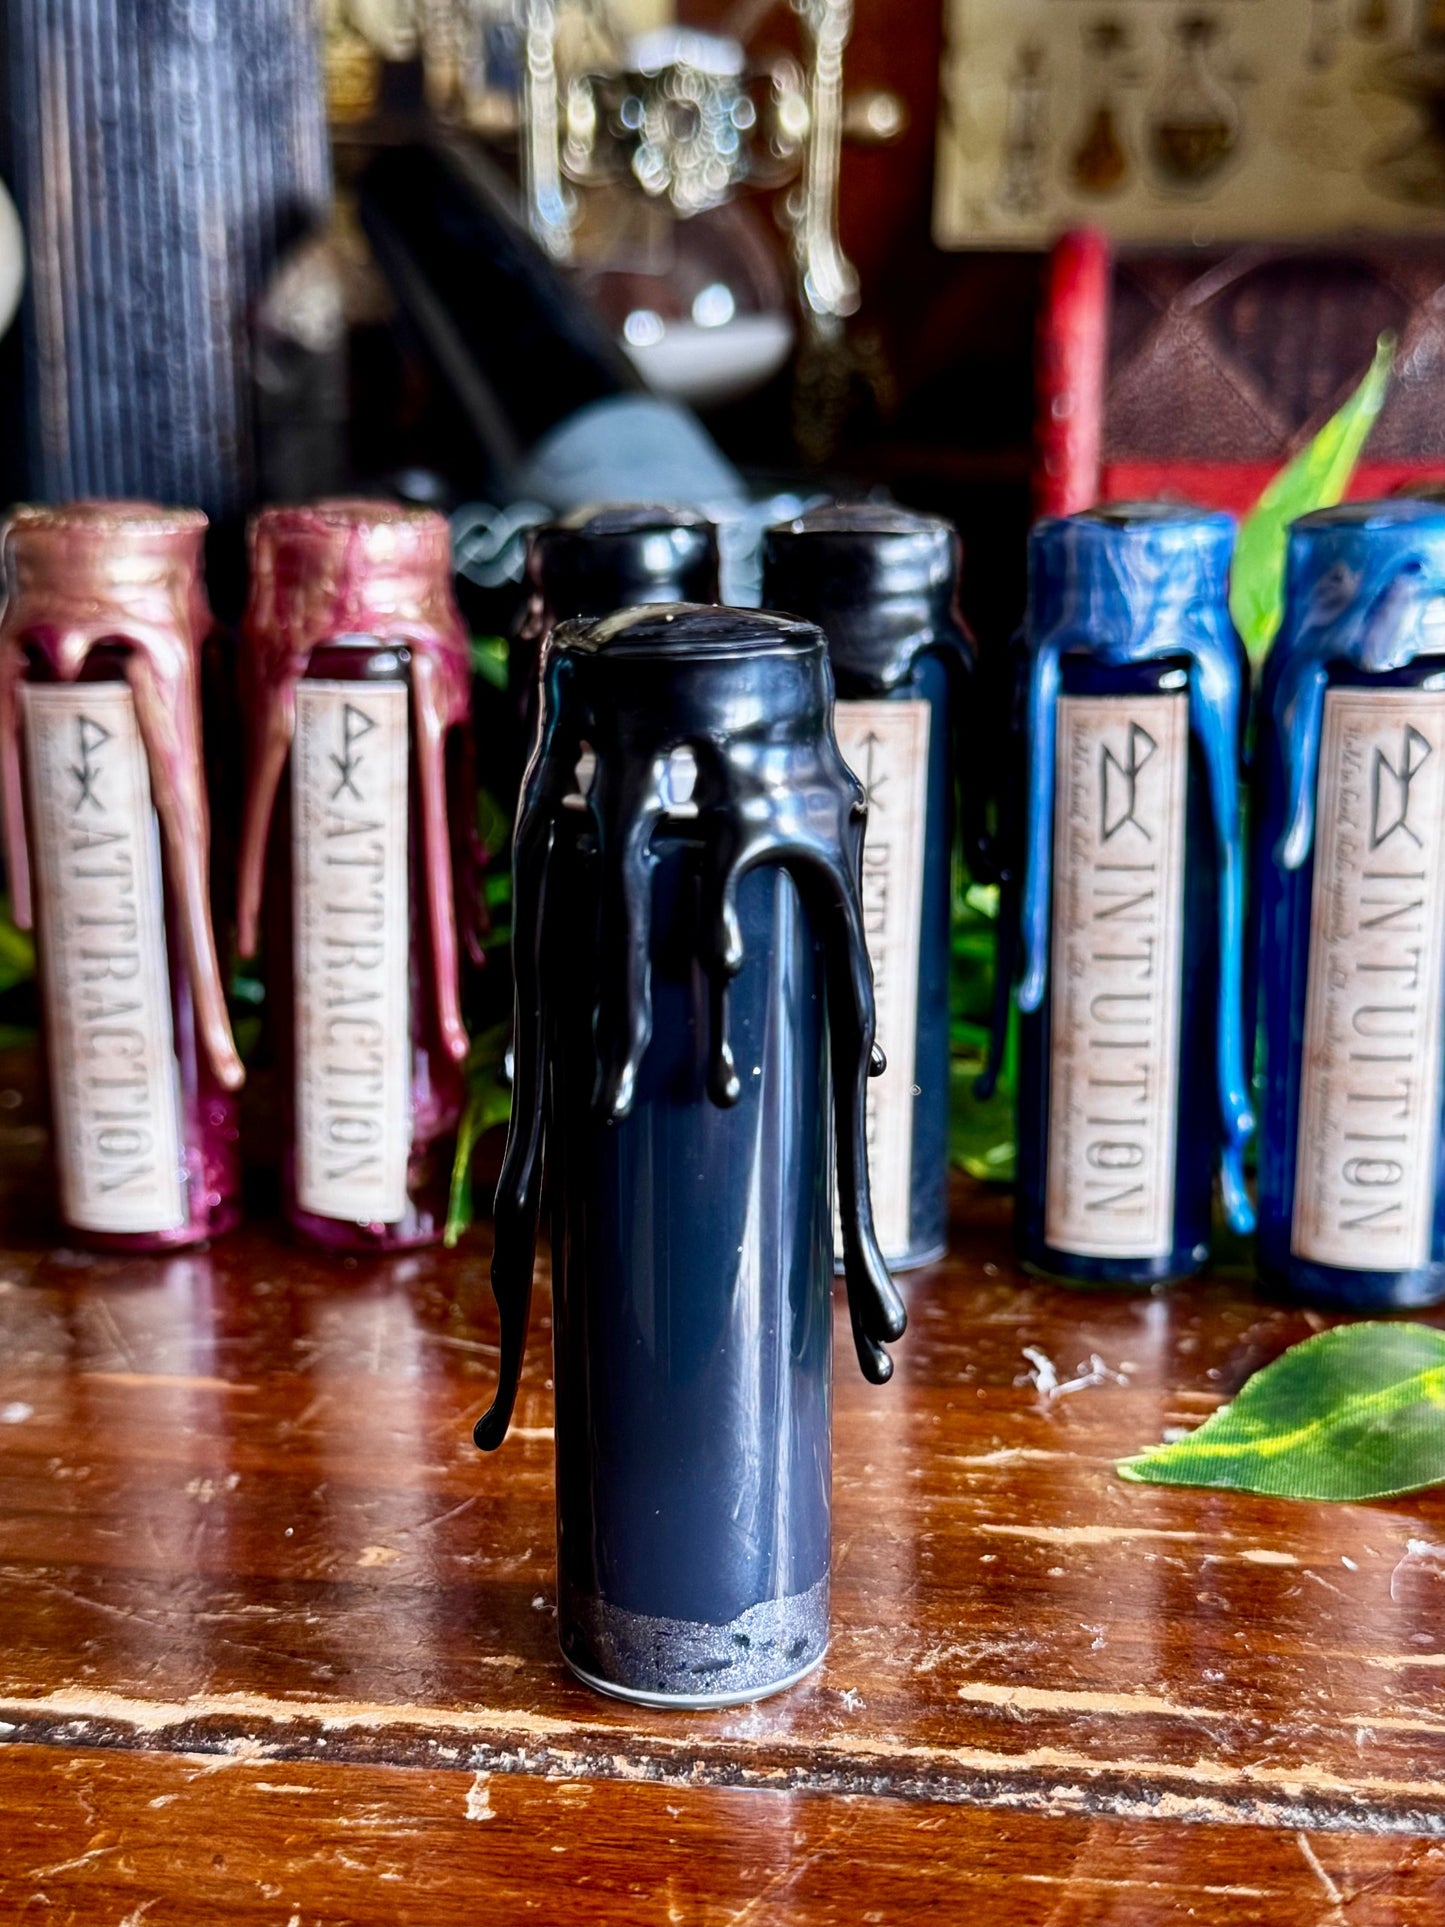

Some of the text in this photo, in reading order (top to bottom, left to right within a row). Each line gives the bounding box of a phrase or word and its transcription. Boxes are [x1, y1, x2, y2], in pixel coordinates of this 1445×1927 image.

[71, 819, 157, 1194] ATTRACTION
[318, 806, 387, 1182] ATTRACTION
[1084, 863, 1156, 1216] INTUITION
[1338, 870, 1427, 1234] INTUITION
